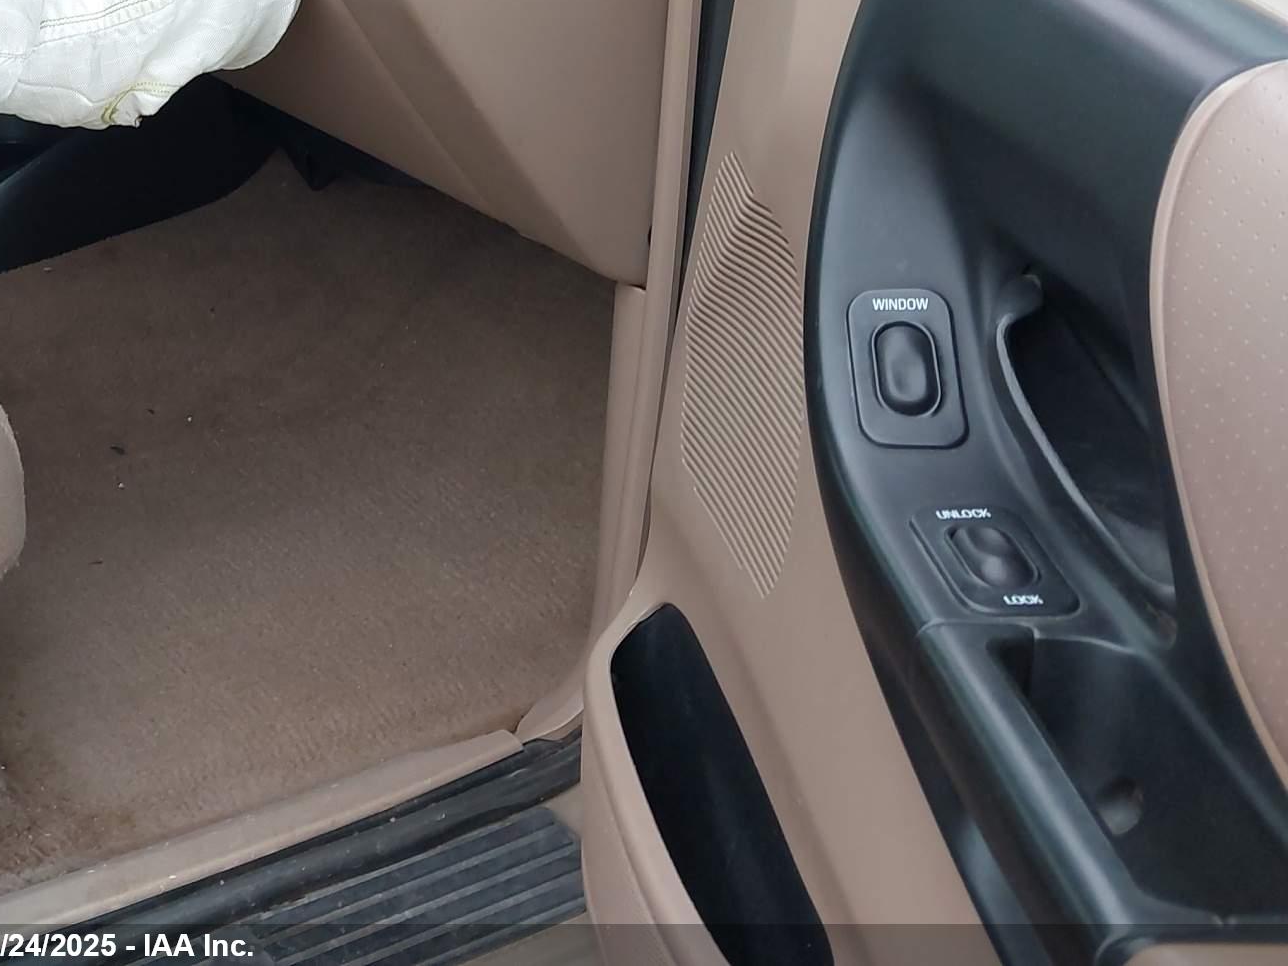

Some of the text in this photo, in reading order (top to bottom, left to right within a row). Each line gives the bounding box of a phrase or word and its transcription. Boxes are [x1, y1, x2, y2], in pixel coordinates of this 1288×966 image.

[872, 297, 929, 312] WINDOW
[935, 508, 992, 520] UNLOCK
[1003, 594, 1044, 605] LOCK
